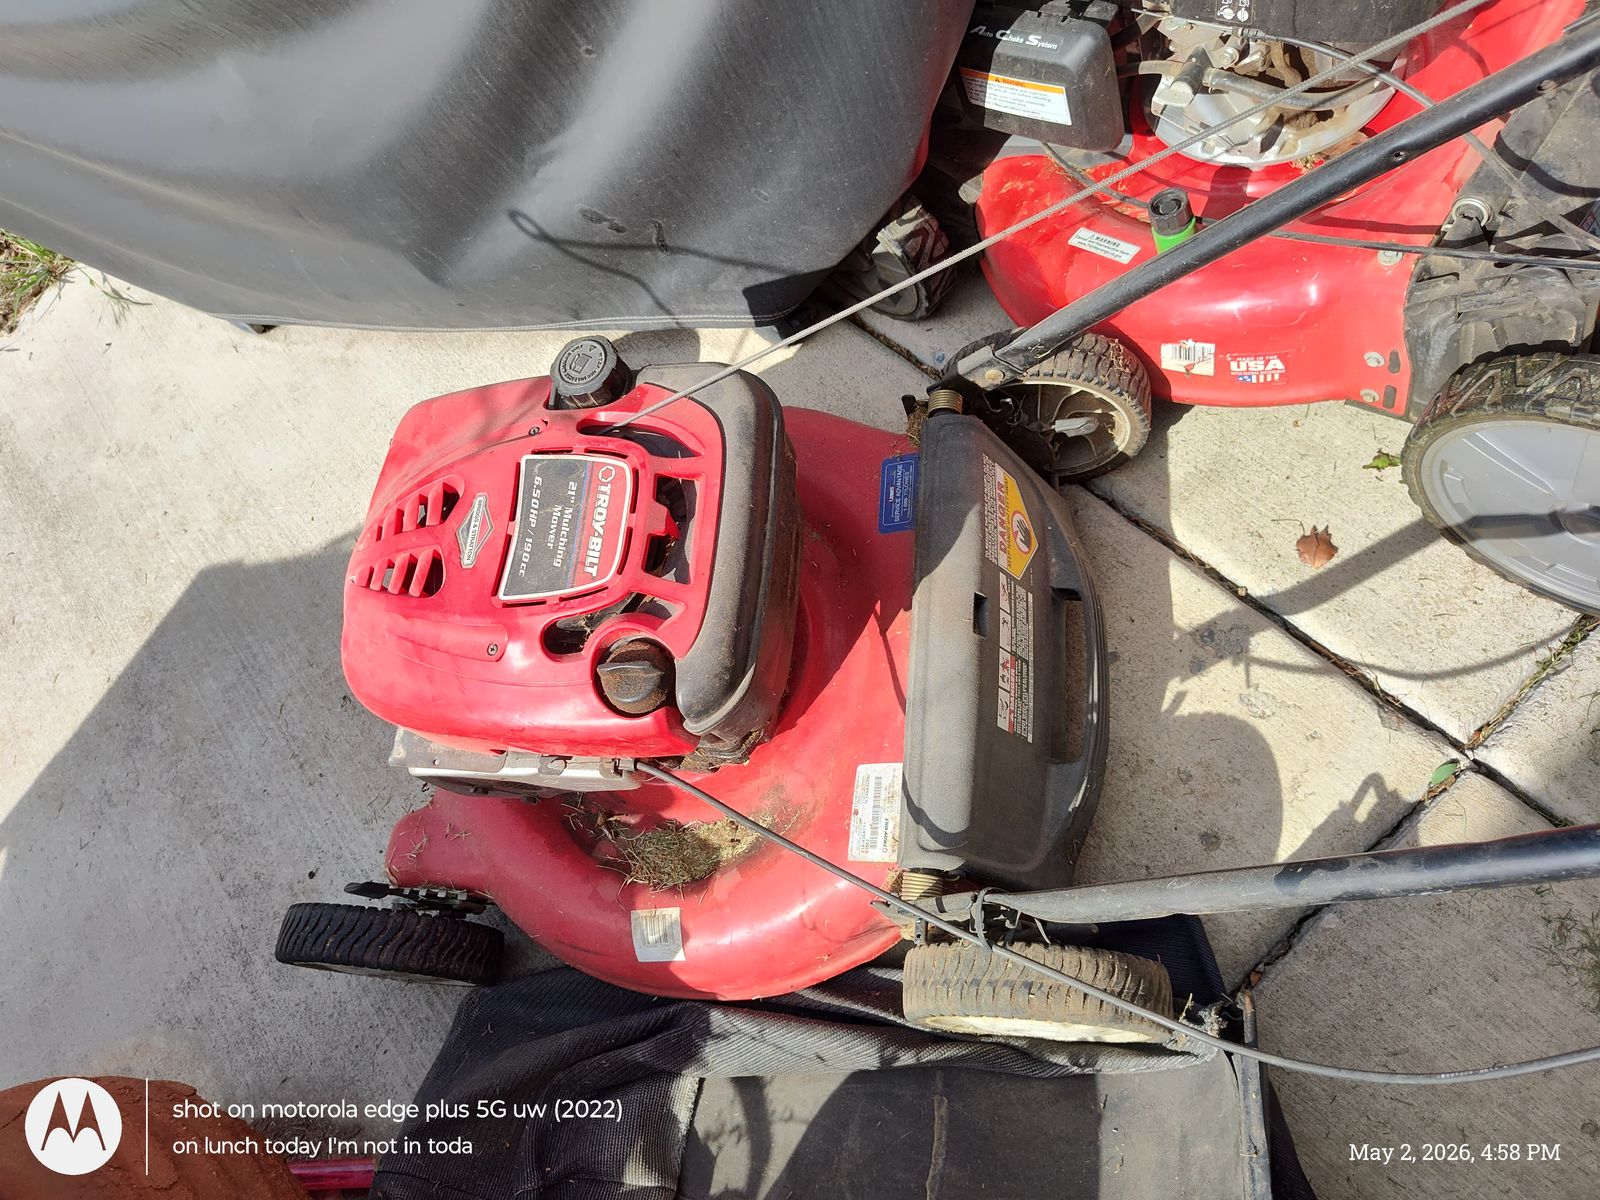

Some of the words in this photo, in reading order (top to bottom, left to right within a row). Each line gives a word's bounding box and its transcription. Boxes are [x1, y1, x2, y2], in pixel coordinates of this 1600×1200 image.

[969, 25, 993, 38] Auto
[995, 29, 1023, 43] Choke
[1025, 34, 1057, 50] System
[1095, 236, 1121, 248] WARNING
[1229, 359, 1285, 372] USA
[474, 499, 482, 523] BRIGGS
[997, 480, 1006, 555] DANGER
[547, 505, 562, 550] Mower
[553, 508, 573, 568] Mulching
[584, 483, 610, 577] TROY-BILT
[466, 529, 478, 561] STRATTON
